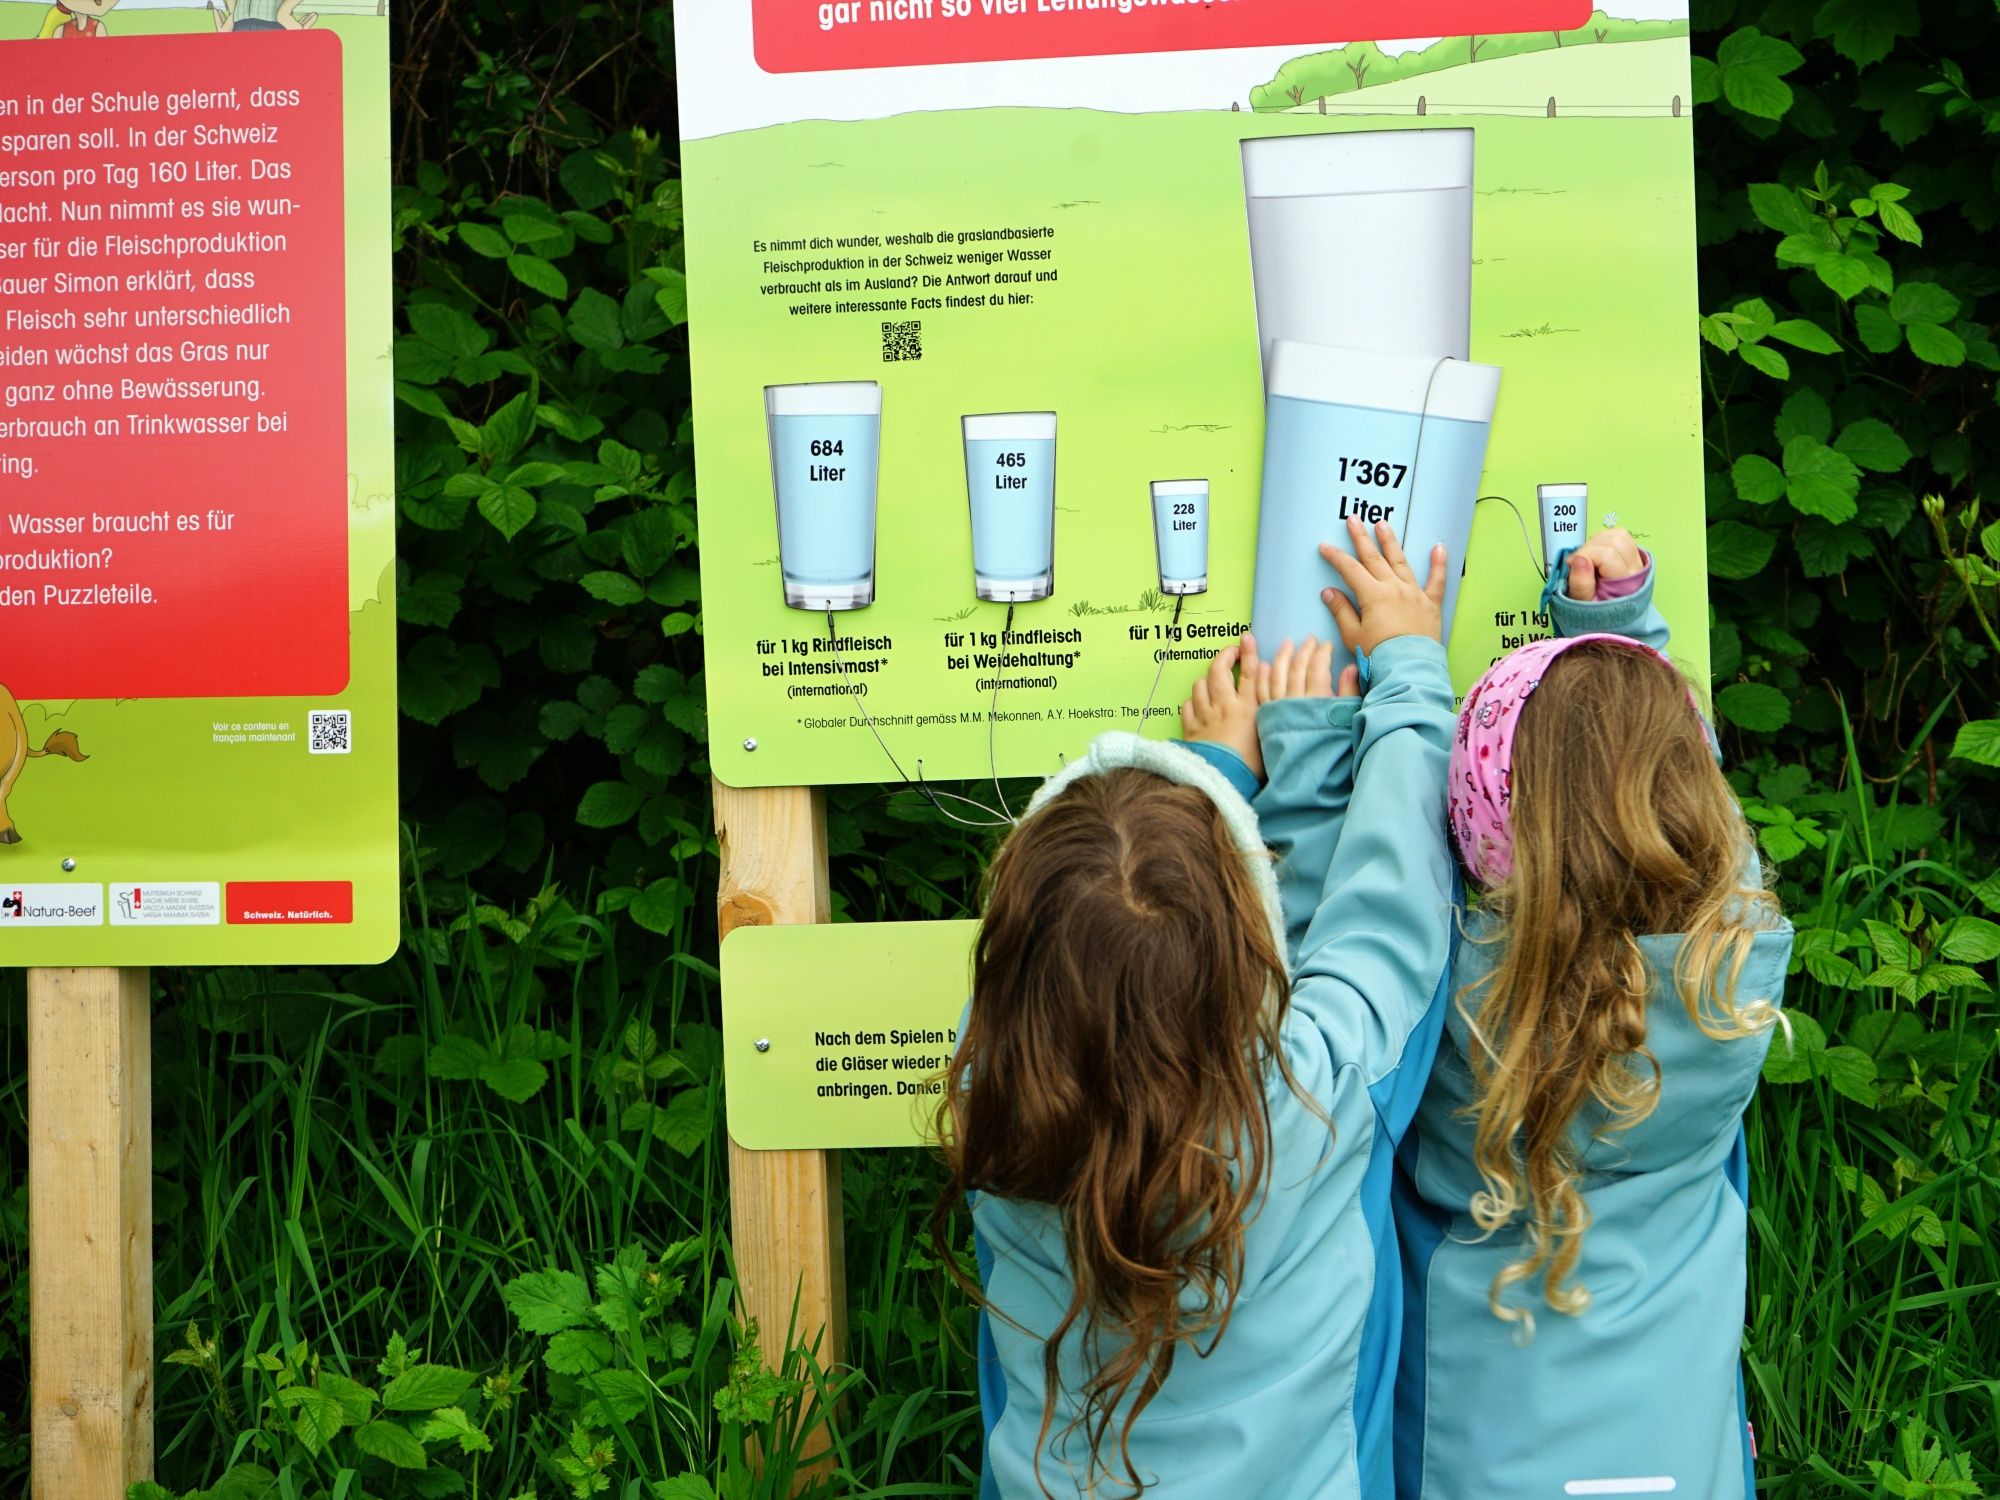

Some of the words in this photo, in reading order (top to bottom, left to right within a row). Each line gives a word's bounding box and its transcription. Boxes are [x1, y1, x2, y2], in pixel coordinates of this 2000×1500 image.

[819, 2, 861, 30] gar
[941, 0, 971, 17] so
[27, 95, 43, 114] in
[52, 94, 84, 114] der
[92, 91, 159, 112] Schule
[167, 88, 240, 115] gelernt,
[250, 87, 299, 107] dass
[2, 134, 70, 155] sparen
[79, 128, 119, 149] soll.
[130, 128, 146, 147] In
[155, 126, 187, 146] der
[194, 123, 277, 145] Schweiz
[0, 170, 54, 187] erson
[64, 169, 95, 190] pro
[103, 164, 138, 188] Tag
[149, 161, 187, 182] 160
[196, 161, 241, 181] Liter.
[252, 159, 291, 179] Das
[0, 202, 51, 222] acht.
[62, 201, 101, 221] Nun
[110, 198, 174, 219] nimmt
[181, 201, 204, 217] es
[212, 196, 240, 216] sie
[248, 199, 300, 215] wun-
[33, 238, 60, 257] für
[68, 237, 97, 256] die
[106, 232, 286, 258] Fleischproduktion
[754, 241, 766, 252] Es
[770, 239, 806, 251] nimmt
[810, 237, 833, 249] dich
[837, 235, 881, 248] wunder,
[885, 232, 933, 245] weshalb
[937, 231, 954, 243] die
[958, 227, 1054, 244] graslandbasierte
[764, 258, 864, 274] Fleischproduktion
[869, 257, 878, 268] in
[883, 256, 901, 267] der
[906, 253, 953, 266] Schweiz
[957, 251, 1003, 265] weniger
[1007, 250, 1051, 261] Wasser
[0, 278, 47, 294] auer
[55, 273, 118, 293] Simon
[127, 270, 195, 292] erklärt,
[205, 269, 254, 289] dass
[760, 281, 821, 295] verbraucht
[825, 280, 842, 292] als
[846, 279, 860, 291] im
[865, 276, 918, 290] Ausland?
[923, 275, 941, 287] Die
[946, 273, 990, 286] Antwort
[995, 270, 1031, 283] darauf
[1036, 269, 1057, 281] und
[789, 303, 831, 315] weitere
[836, 299, 907, 313] interessante
[912, 298, 942, 309] Facts
[946, 295, 985, 307] findest
[990, 294, 1003, 305] du
[1009, 293, 1033, 304] hier:
[7, 309, 75, 330] Fleisch
[84, 308, 127, 328] sehr
[136, 303, 290, 326] unterschiedlich
[55, 343, 129, 364] wächst
[136, 343, 173, 362] das
[181, 341, 228, 361] Gras
[237, 344, 269, 360] nur
[6, 385, 55, 407] ganz
[63, 380, 113, 400] ohne
[122, 378, 264, 401] Bewässerung.
[0, 416, 86, 438] erbrauch
[95, 420, 119, 435] an
[127, 414, 250, 434] Trinkwasser
[258, 411, 287, 432] bei
[811, 440, 843, 456] 684
[997, 453, 1025, 467] 465
[811, 465, 845, 481] Liter
[996, 475, 1027, 489] Liter
[1174, 504, 1195, 514] 228
[1339, 496, 1394, 524] Liter
[1554, 505, 1576, 516] 200
[9, 514, 85, 534] Wasser
[93, 511, 170, 532] braucht
[177, 515, 200, 531] es
[207, 510, 234, 530] für
[1173, 520, 1196, 530] Liter
[1554, 522, 1577, 532] Liter
[44, 584, 156, 605] Puzzleteile.
[1495, 612, 1515, 626] für
[1521, 611, 1526, 625] 1
[1532, 611, 1549, 628] kg
[945, 633, 964, 647] für
[970, 632, 975, 646] 1
[981, 632, 996, 649] kg
[1002, 629, 1082, 647] Rindfleisch
[1129, 625, 1149, 640] für
[1155, 625, 1160, 639] 1
[1165, 624, 1182, 642] kg
[1187, 622, 1251, 638] Getreide
[1502, 634, 1524, 649] bei
[757, 640, 776, 654] für
[782, 640, 787, 653] 1
[792, 639, 808, 656] kg
[813, 635, 892, 653] Rindfleisch
[763, 662, 783, 676] bei
[948, 655, 969, 669] bei
[788, 683, 867, 699] (international)
[976, 675, 1057, 693] (international)
[213, 722, 229, 731] Voir
[231, 723, 242, 731] ce
[243, 721, 277, 731] contenu
[279, 722, 289, 730] en
[850, 714, 914, 728] Durchschnitt
[916, 714, 956, 727] gemäss
[960, 712, 985, 723] M.M.
[1048, 709, 1065, 720] A.Y.
[1069, 708, 1116, 718] Hoekstra:
[1121, 707, 1139, 716] The
[1143, 705, 1174, 719] green,
[23, 905, 96, 918] Natura-Beef
[243, 911, 284, 920] Schweiz.
[287, 910, 333, 919] Natürlich.
[815, 1032, 850, 1046] Nach
[855, 1031, 885, 1045] dem
[890, 1030, 943, 1047] Spielen
[816, 1058, 837, 1071] die
[842, 1056, 888, 1071] Gläser
[892, 1055, 940, 1069] wieder
[817, 1083, 892, 1099] anbringen.
